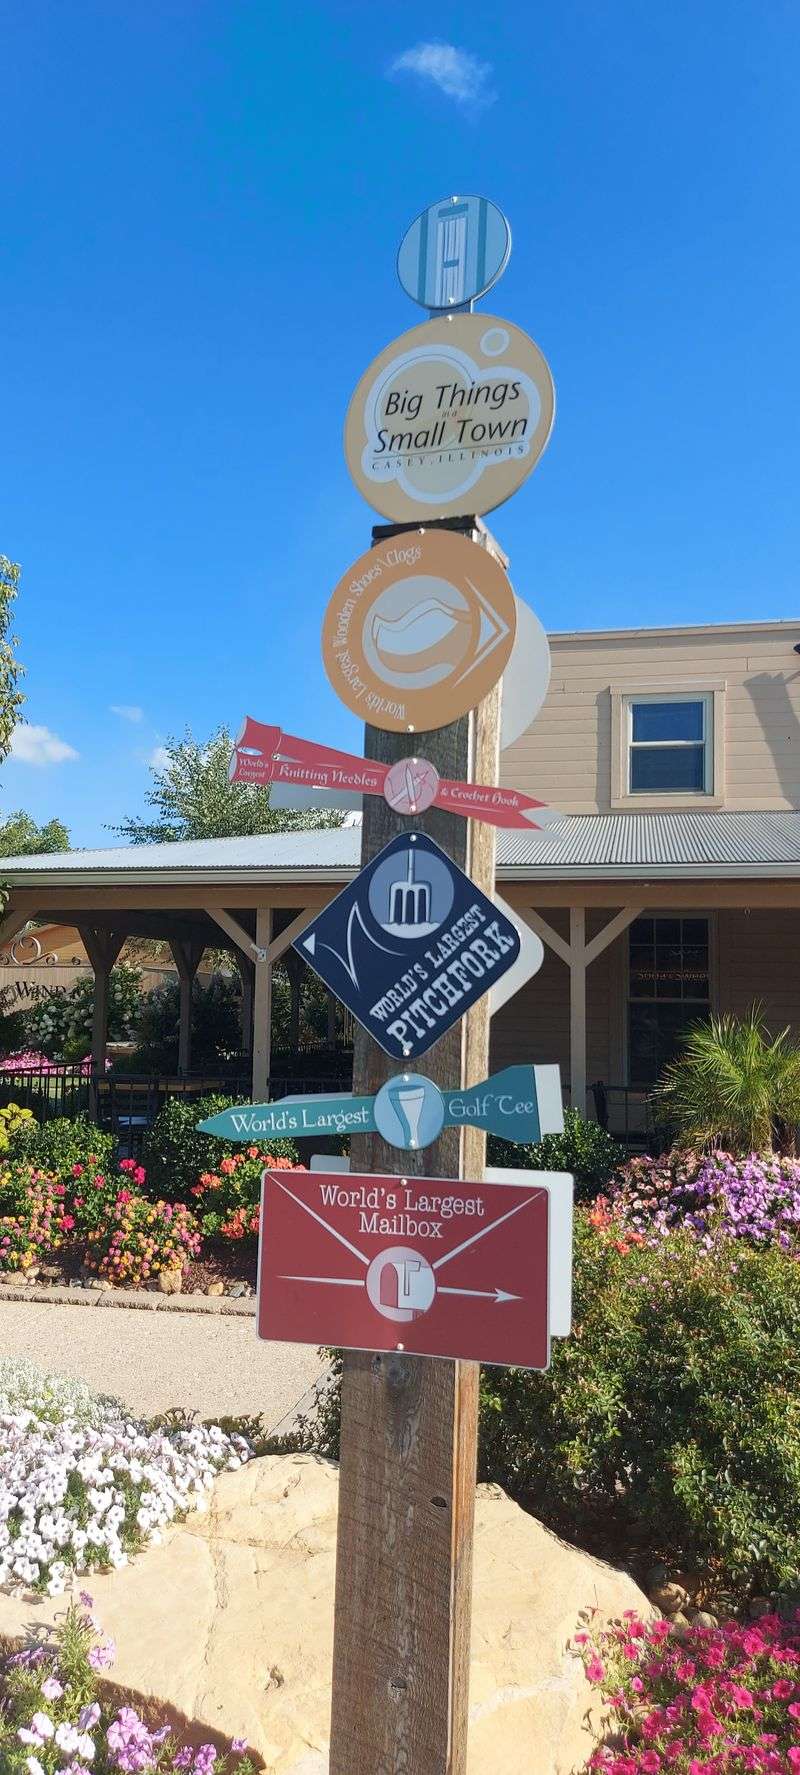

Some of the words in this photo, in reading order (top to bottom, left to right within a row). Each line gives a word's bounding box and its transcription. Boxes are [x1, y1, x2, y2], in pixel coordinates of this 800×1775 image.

[384, 390, 423, 420] Big
[436, 381, 521, 410] Things
[374, 421, 445, 453] Small
[457, 417, 528, 443] Town
[438, 446, 525, 463] ILLINOIS
[332, 598, 357, 648] Wooden
[279, 763, 328, 785] Knitting
[332, 769, 377, 787] Needles
[441, 788, 449, 796] &
[450, 787, 489, 803] Crochet
[491, 792, 519, 807] Hook
[369, 962, 429, 1023] WORLD'S
[424, 903, 487, 969] LARGEST
[386, 920, 516, 1051] PITCHFORK
[448, 1094, 491, 1118] Golf
[498, 1095, 534, 1115] Tee
[230, 1112, 297, 1134] World's
[300, 1108, 369, 1131] Largest
[320, 1185, 397, 1210] World's
[404, 1189, 484, 1218] Largest
[358, 1212, 443, 1238] Mailbox
